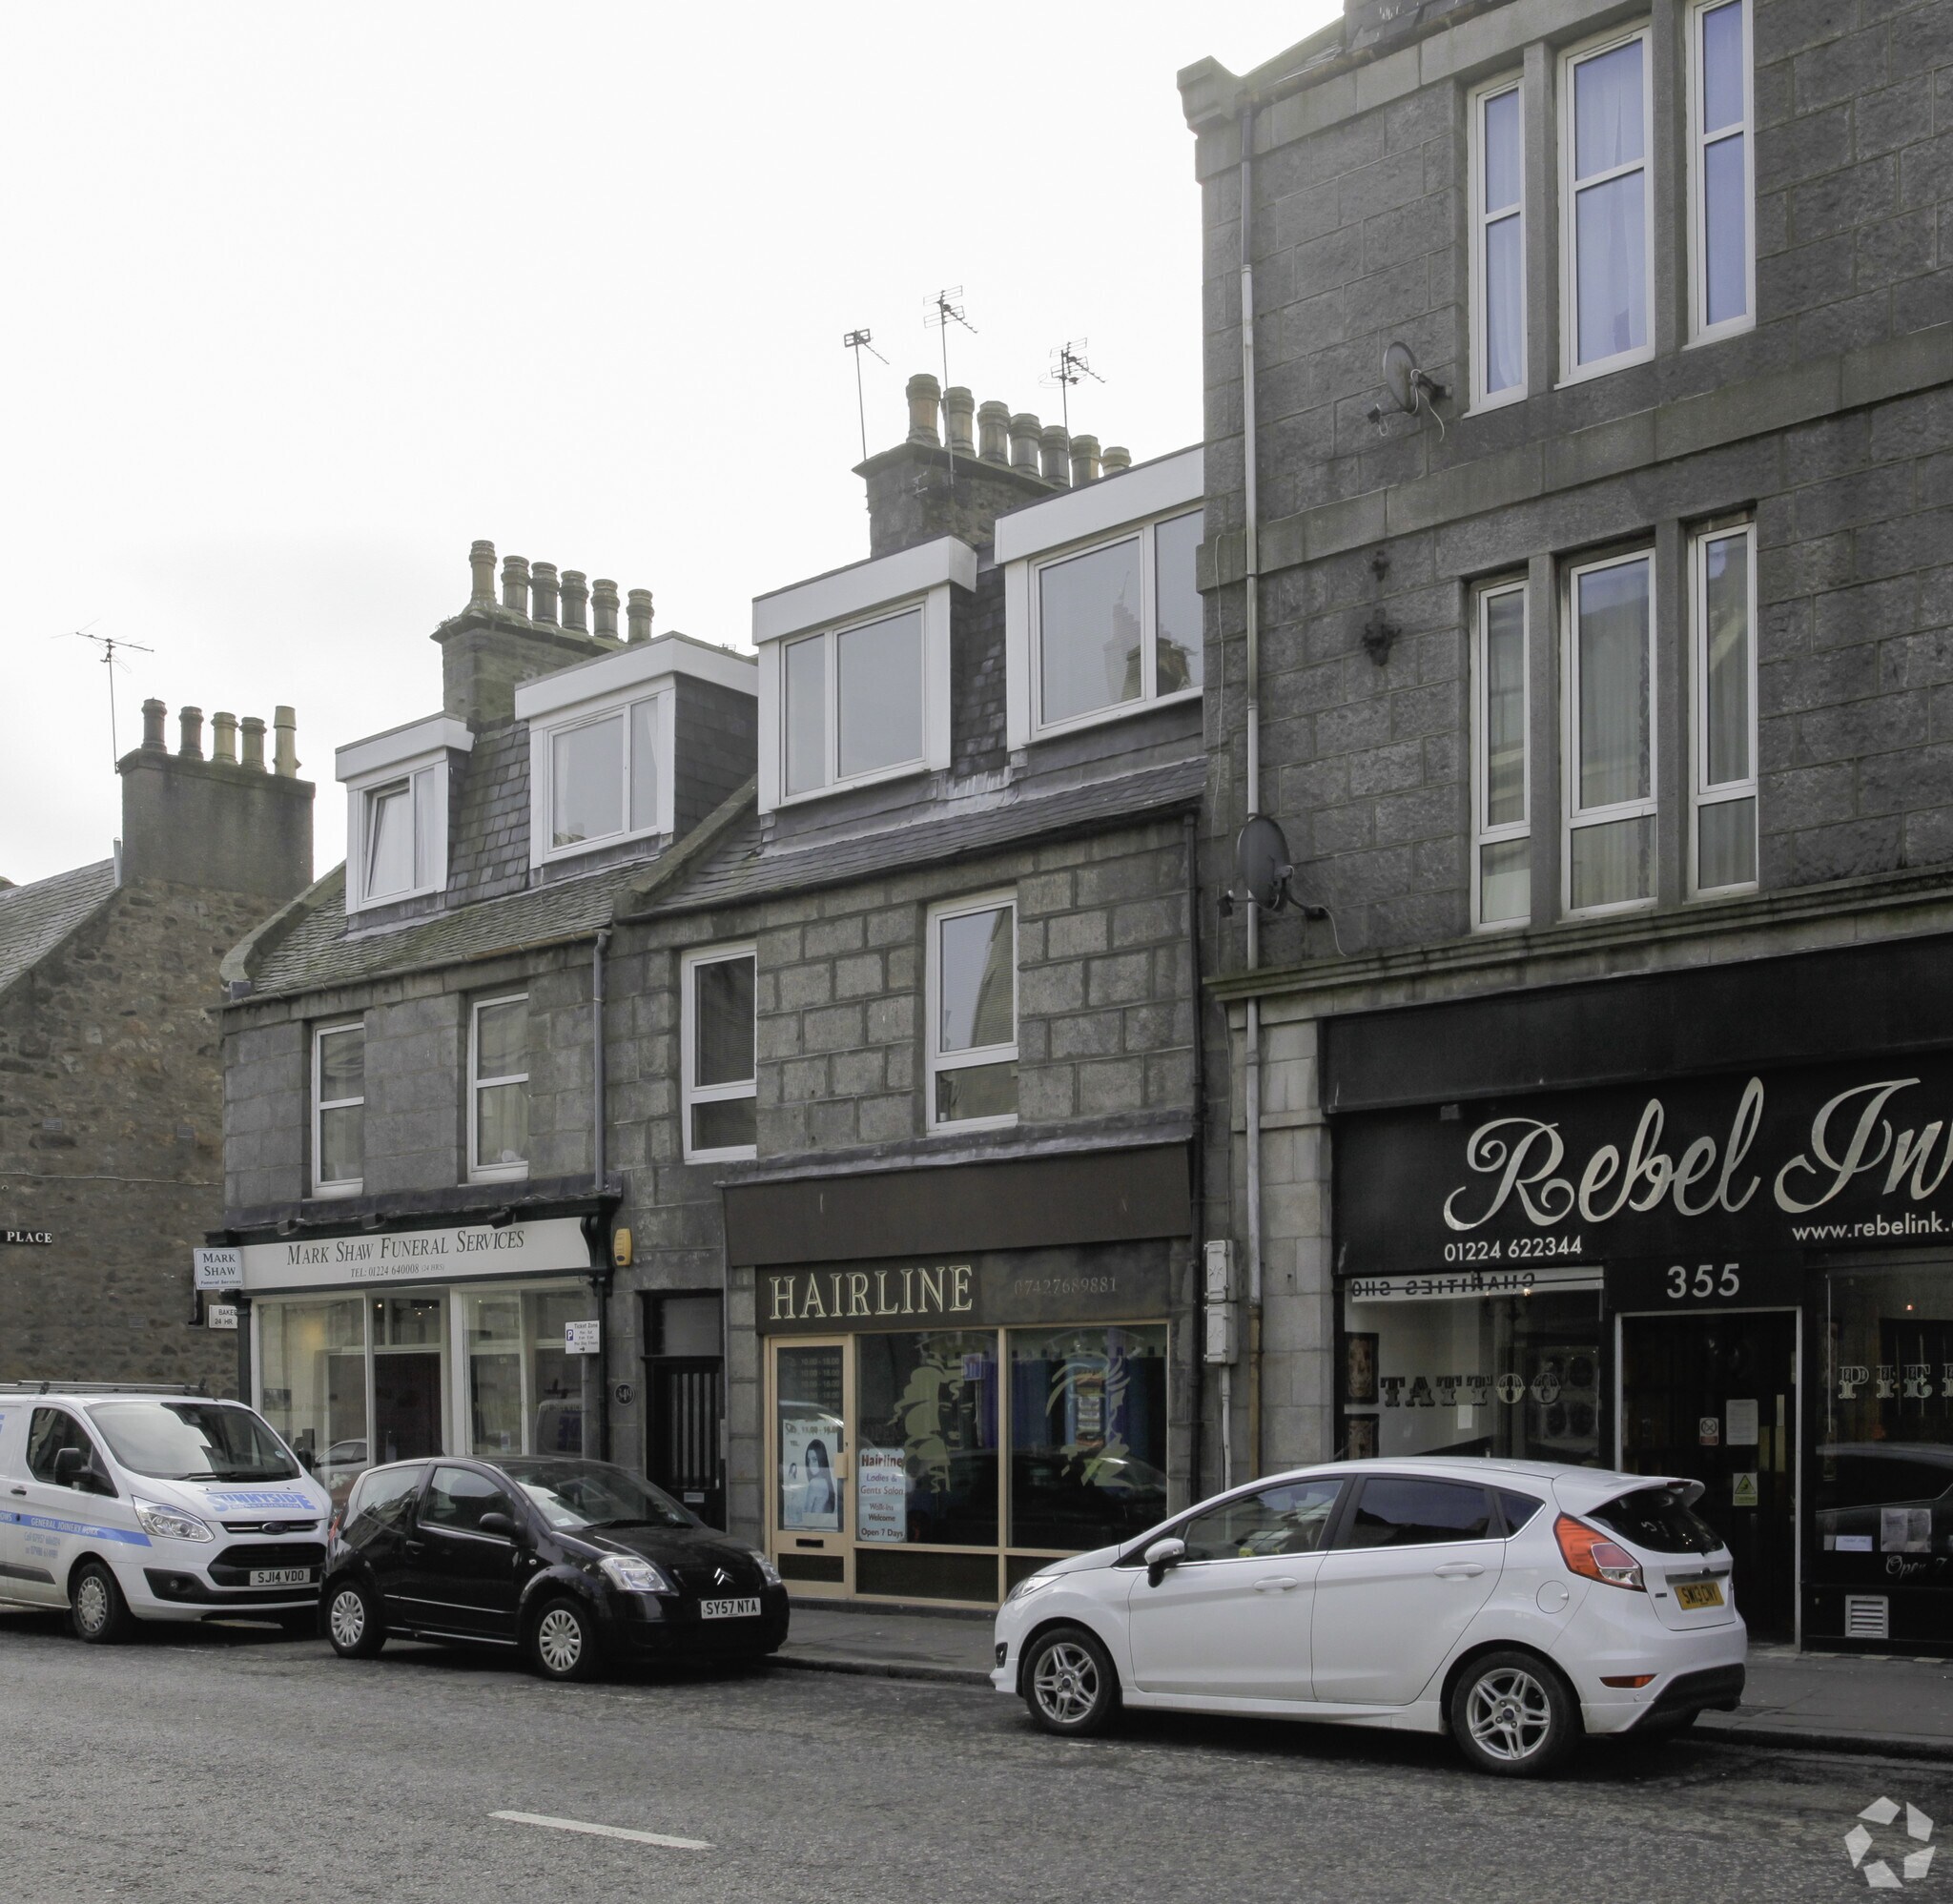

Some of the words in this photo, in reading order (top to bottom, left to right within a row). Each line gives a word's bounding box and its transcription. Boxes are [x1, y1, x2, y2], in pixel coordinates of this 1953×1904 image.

[1444, 1076, 1764, 1231] Rebel
[1774, 1077, 1953, 1214] In
[1792, 1211, 1953, 1241] www.rebelink.
[7, 1231, 52, 1243] PLACE
[287, 1244, 330, 1266] MARK
[336, 1240, 375, 1263] SHAW
[380, 1237, 449, 1259] FUNERAL
[456, 1230, 524, 1253] SERVICES
[1444, 1240, 1502, 1262] 01224
[1508, 1235, 1582, 1259] 622344
[203, 1253, 236, 1263] MARK
[204, 1266, 236, 1277] SHAW
[351, 1267, 367, 1279] TEL:
[368, 1265, 389, 1277] 01224
[391, 1263, 420, 1276] 640008
[1666, 1262, 1740, 1299] 355
[770, 1265, 973, 1320] HAIRLINE
[1380, 1373, 1561, 1407] TATTOO
[861, 1454, 903, 1467] Hairline
[866, 1473, 889, 1483] Ladies
[860, 1484, 882, 1495] Gents
[883, 1485, 904, 1495] Salon
[207, 1493, 317, 1512] SUNNYSIDE
[31, 1517, 56, 1529] GENERAL
[57, 1522, 80, 1533] JOINERY
[868, 1513, 895, 1523] Welcome
[861, 1527, 879, 1538] Open
[887, 1528, 904, 1539] Days
[257, 1571, 281, 1584] SJ14
[706, 1601, 734, 1615] SY57
[737, 1600, 757, 1613] NTA
